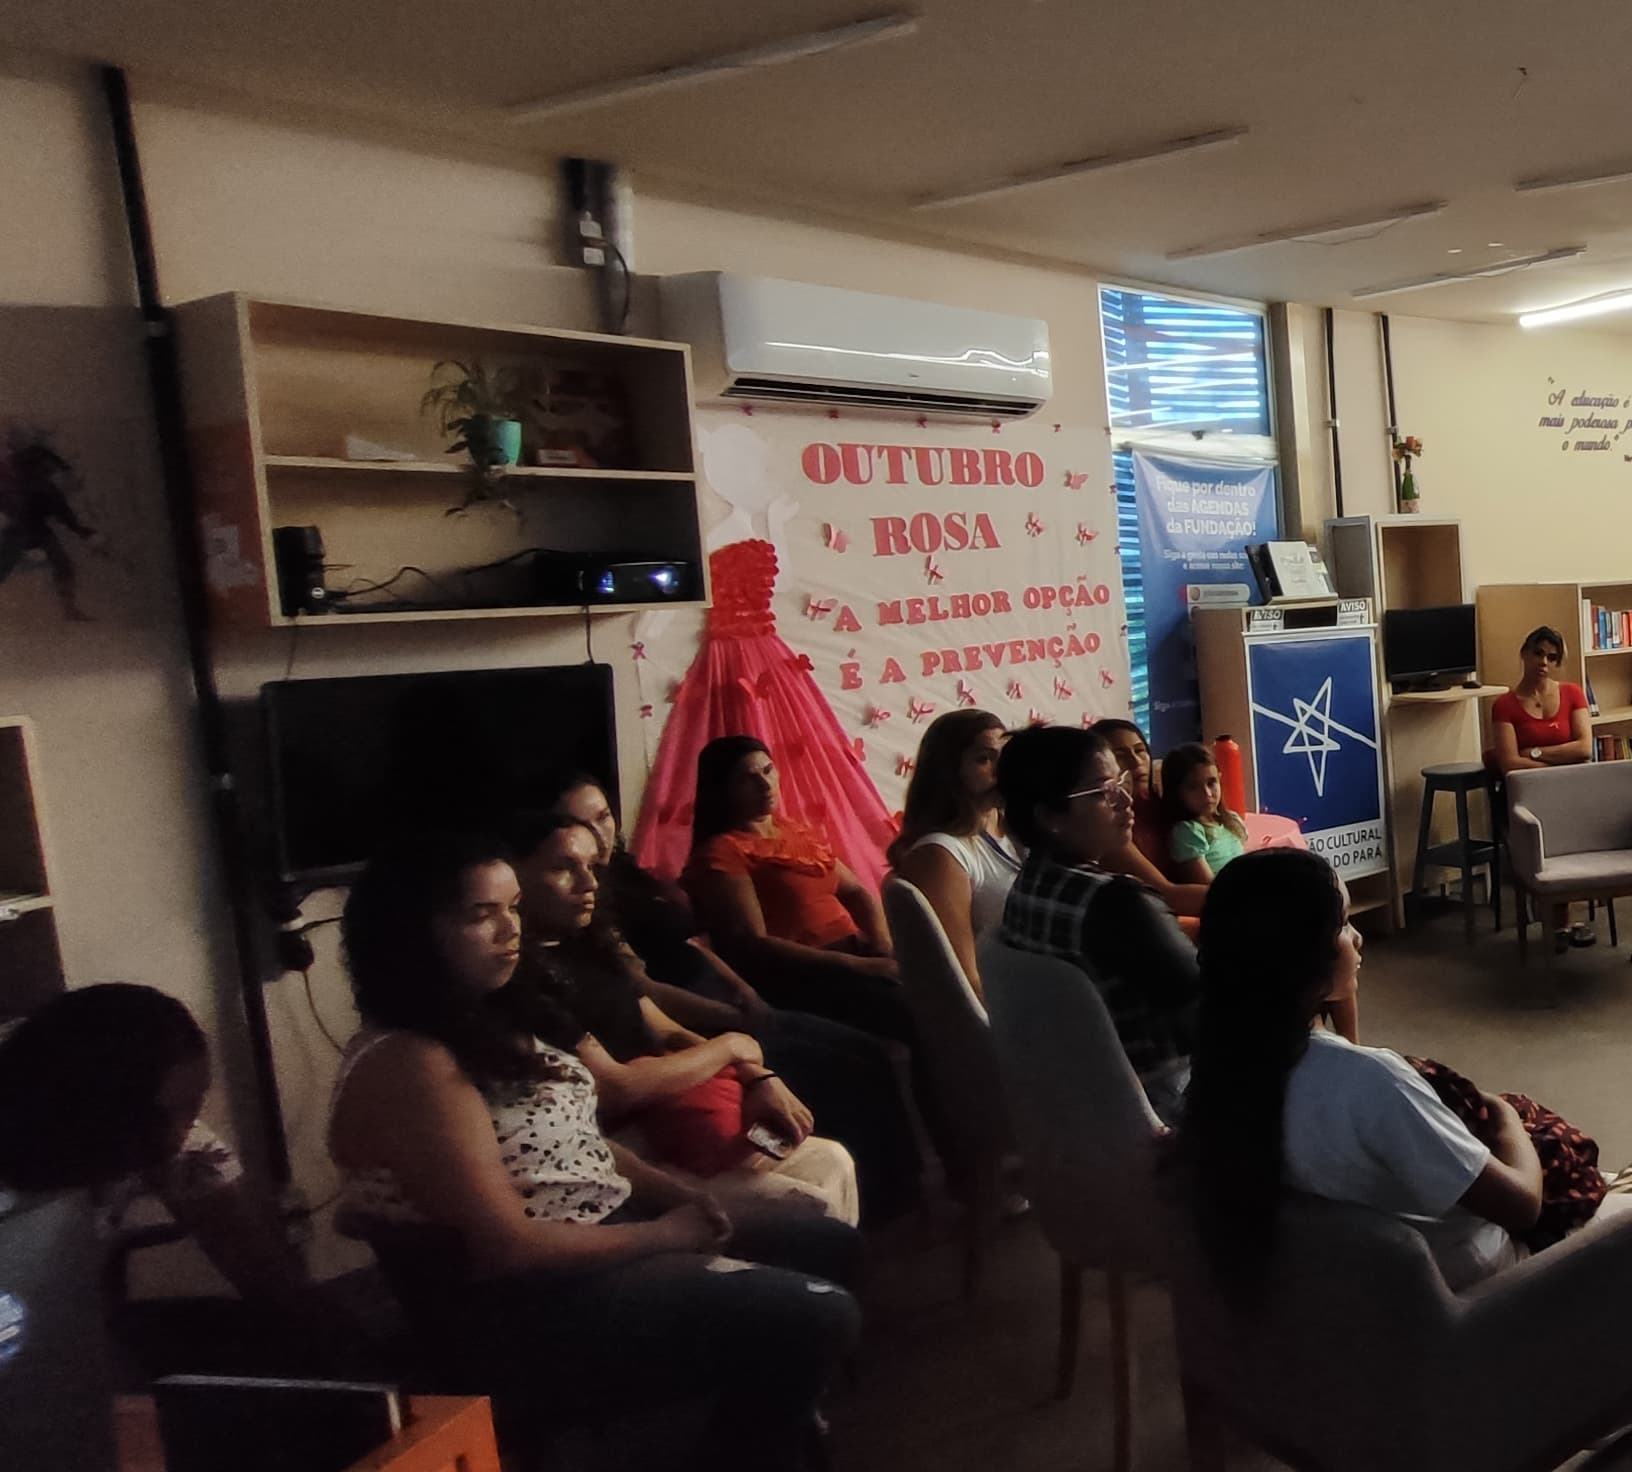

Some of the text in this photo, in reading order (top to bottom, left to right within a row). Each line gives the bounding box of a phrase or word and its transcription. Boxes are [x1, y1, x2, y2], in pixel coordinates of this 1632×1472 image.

[1623, 394, 1632, 409] é
[1538, 412, 1566, 428] mais
[1565, 411, 1619, 435] poderosa
[1562, 440, 1570, 451] o
[801, 442, 1045, 488] OUTUBRO
[1156, 477, 1256, 497] Fique por dentro
[1167, 496, 1249, 516] das AGENDAS
[870, 512, 1001, 557] ROSA
[1167, 516, 1257, 540] da FUNDAÇÃO!
[832, 575, 1110, 633] A MELHOR OPÇÃO
[1340, 601, 1366, 612] AVISO
[1253, 610, 1281, 621] AVISO
[839, 622, 1102, 691] É A PREVENÇÃO
[1326, 828, 1382, 850] CULTURAL
[1333, 852, 1351, 868] DO
